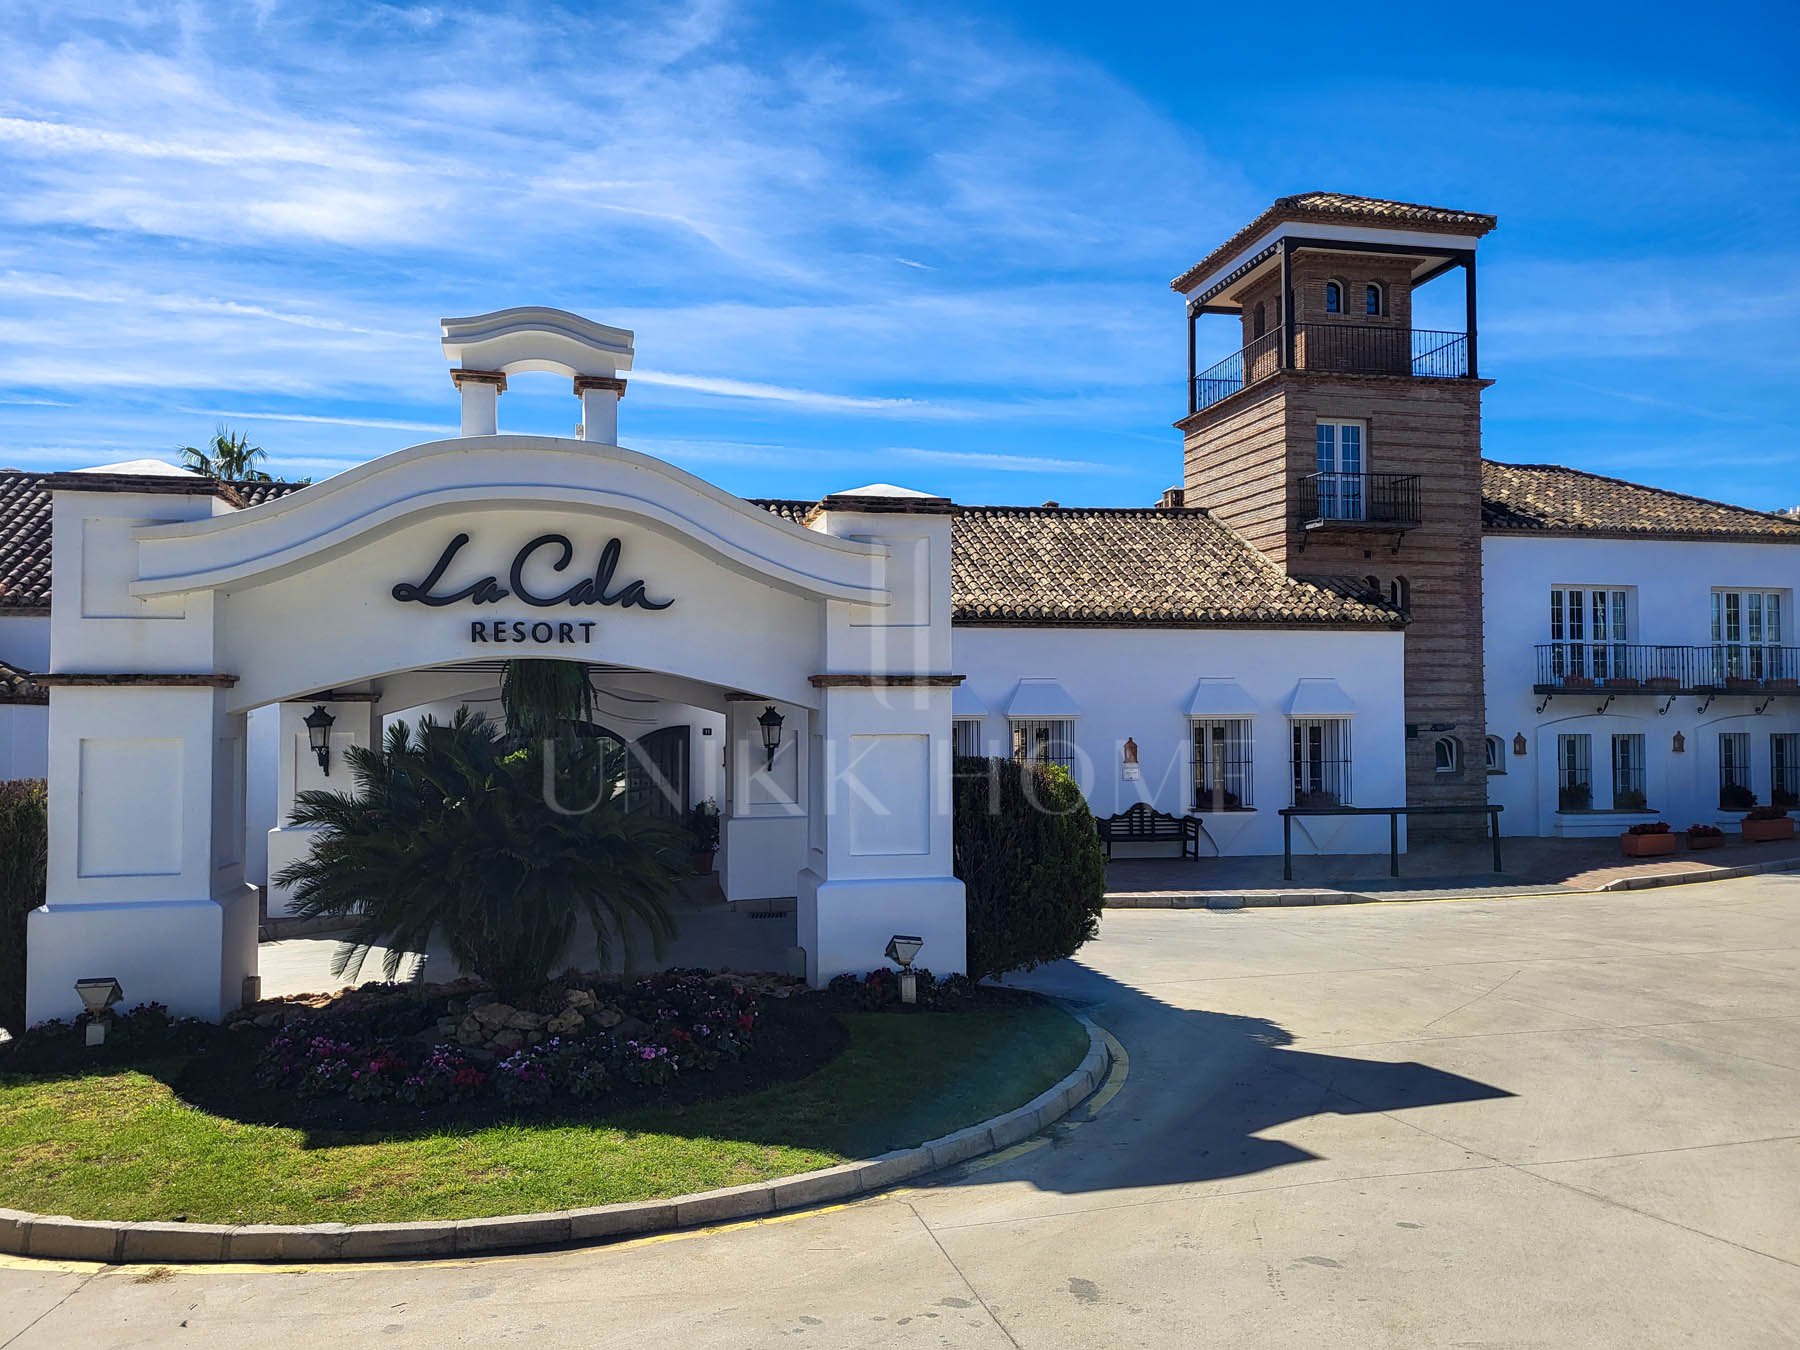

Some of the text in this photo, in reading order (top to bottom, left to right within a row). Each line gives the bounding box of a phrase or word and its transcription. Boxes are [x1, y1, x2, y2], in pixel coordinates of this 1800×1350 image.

[392, 533, 675, 610] La Cala
[471, 621, 597, 644] RESORT
